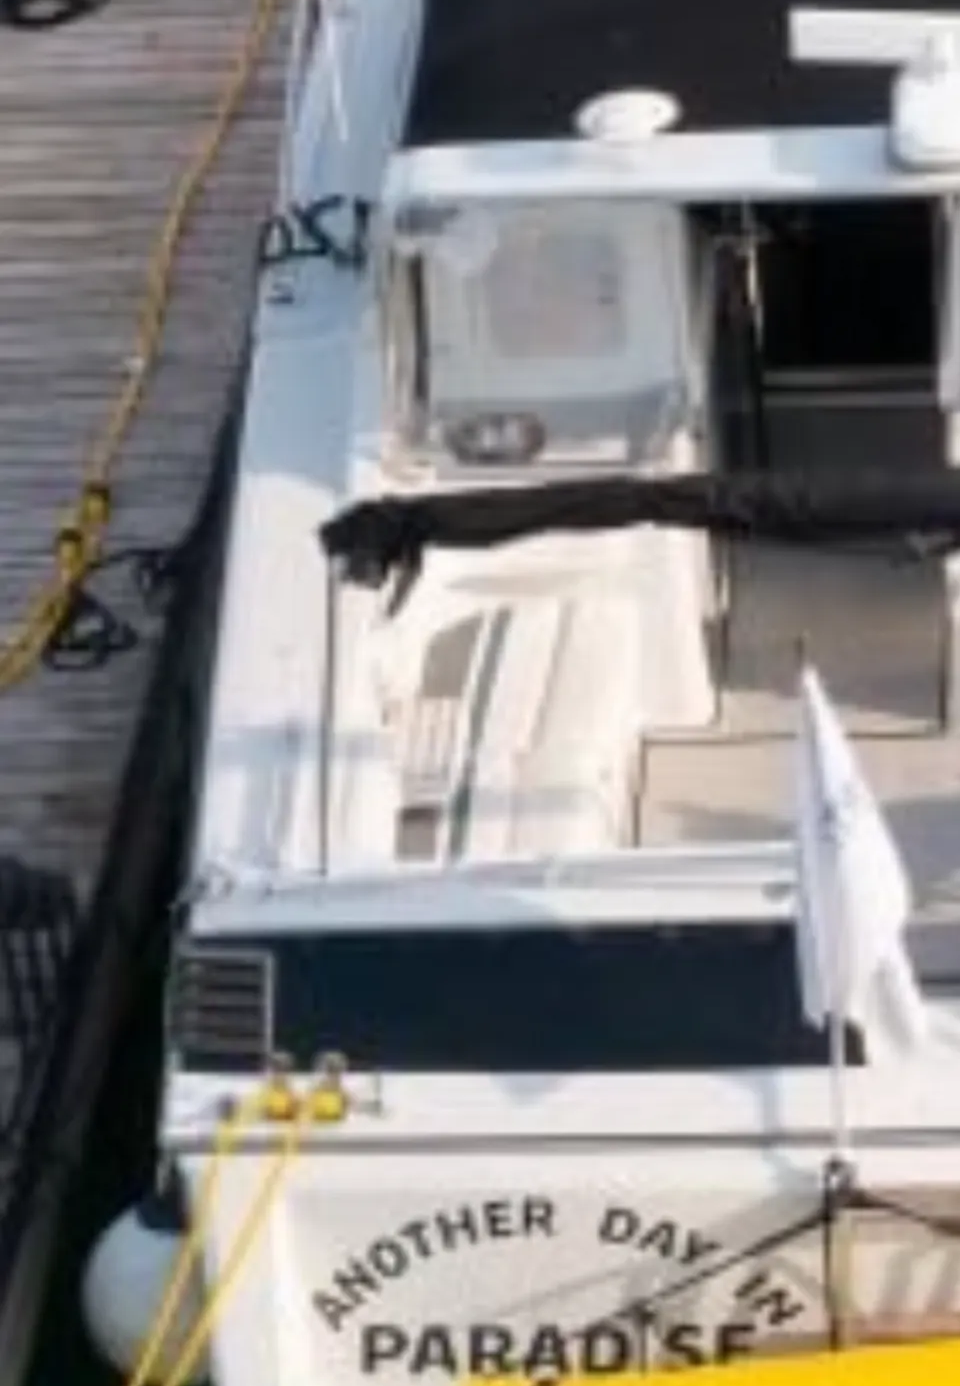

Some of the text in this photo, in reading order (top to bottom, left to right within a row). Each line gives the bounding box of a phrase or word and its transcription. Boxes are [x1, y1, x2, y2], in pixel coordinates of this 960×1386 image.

[311, 1194, 806, 1333] ANOTHER DAY IN
